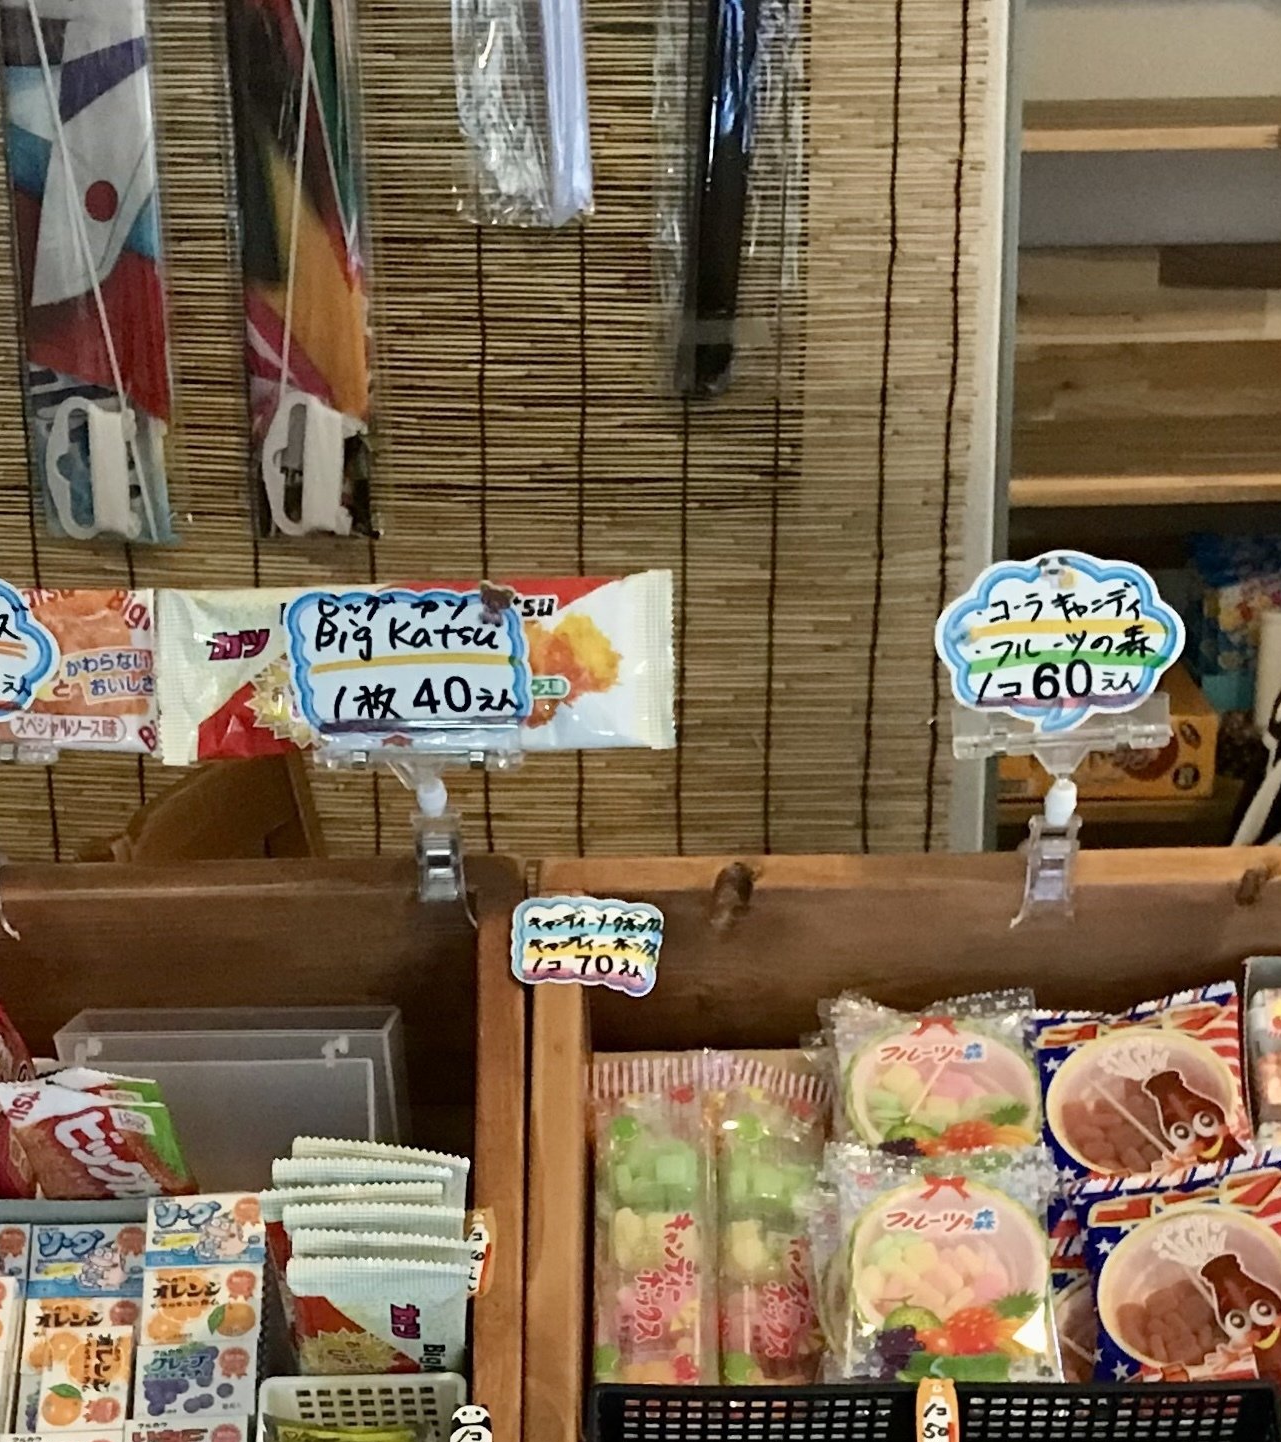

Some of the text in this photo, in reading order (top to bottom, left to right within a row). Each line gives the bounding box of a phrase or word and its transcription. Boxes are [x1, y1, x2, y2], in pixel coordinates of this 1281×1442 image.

[316, 618, 500, 661] Big Katsu
[880, 1043, 985, 1063] フルーツの森
[886, 1209, 997, 1232] フルーツの森
[153, 1281, 221, 1300] オレンジ
[35, 1310, 104, 1328] オレンジ
